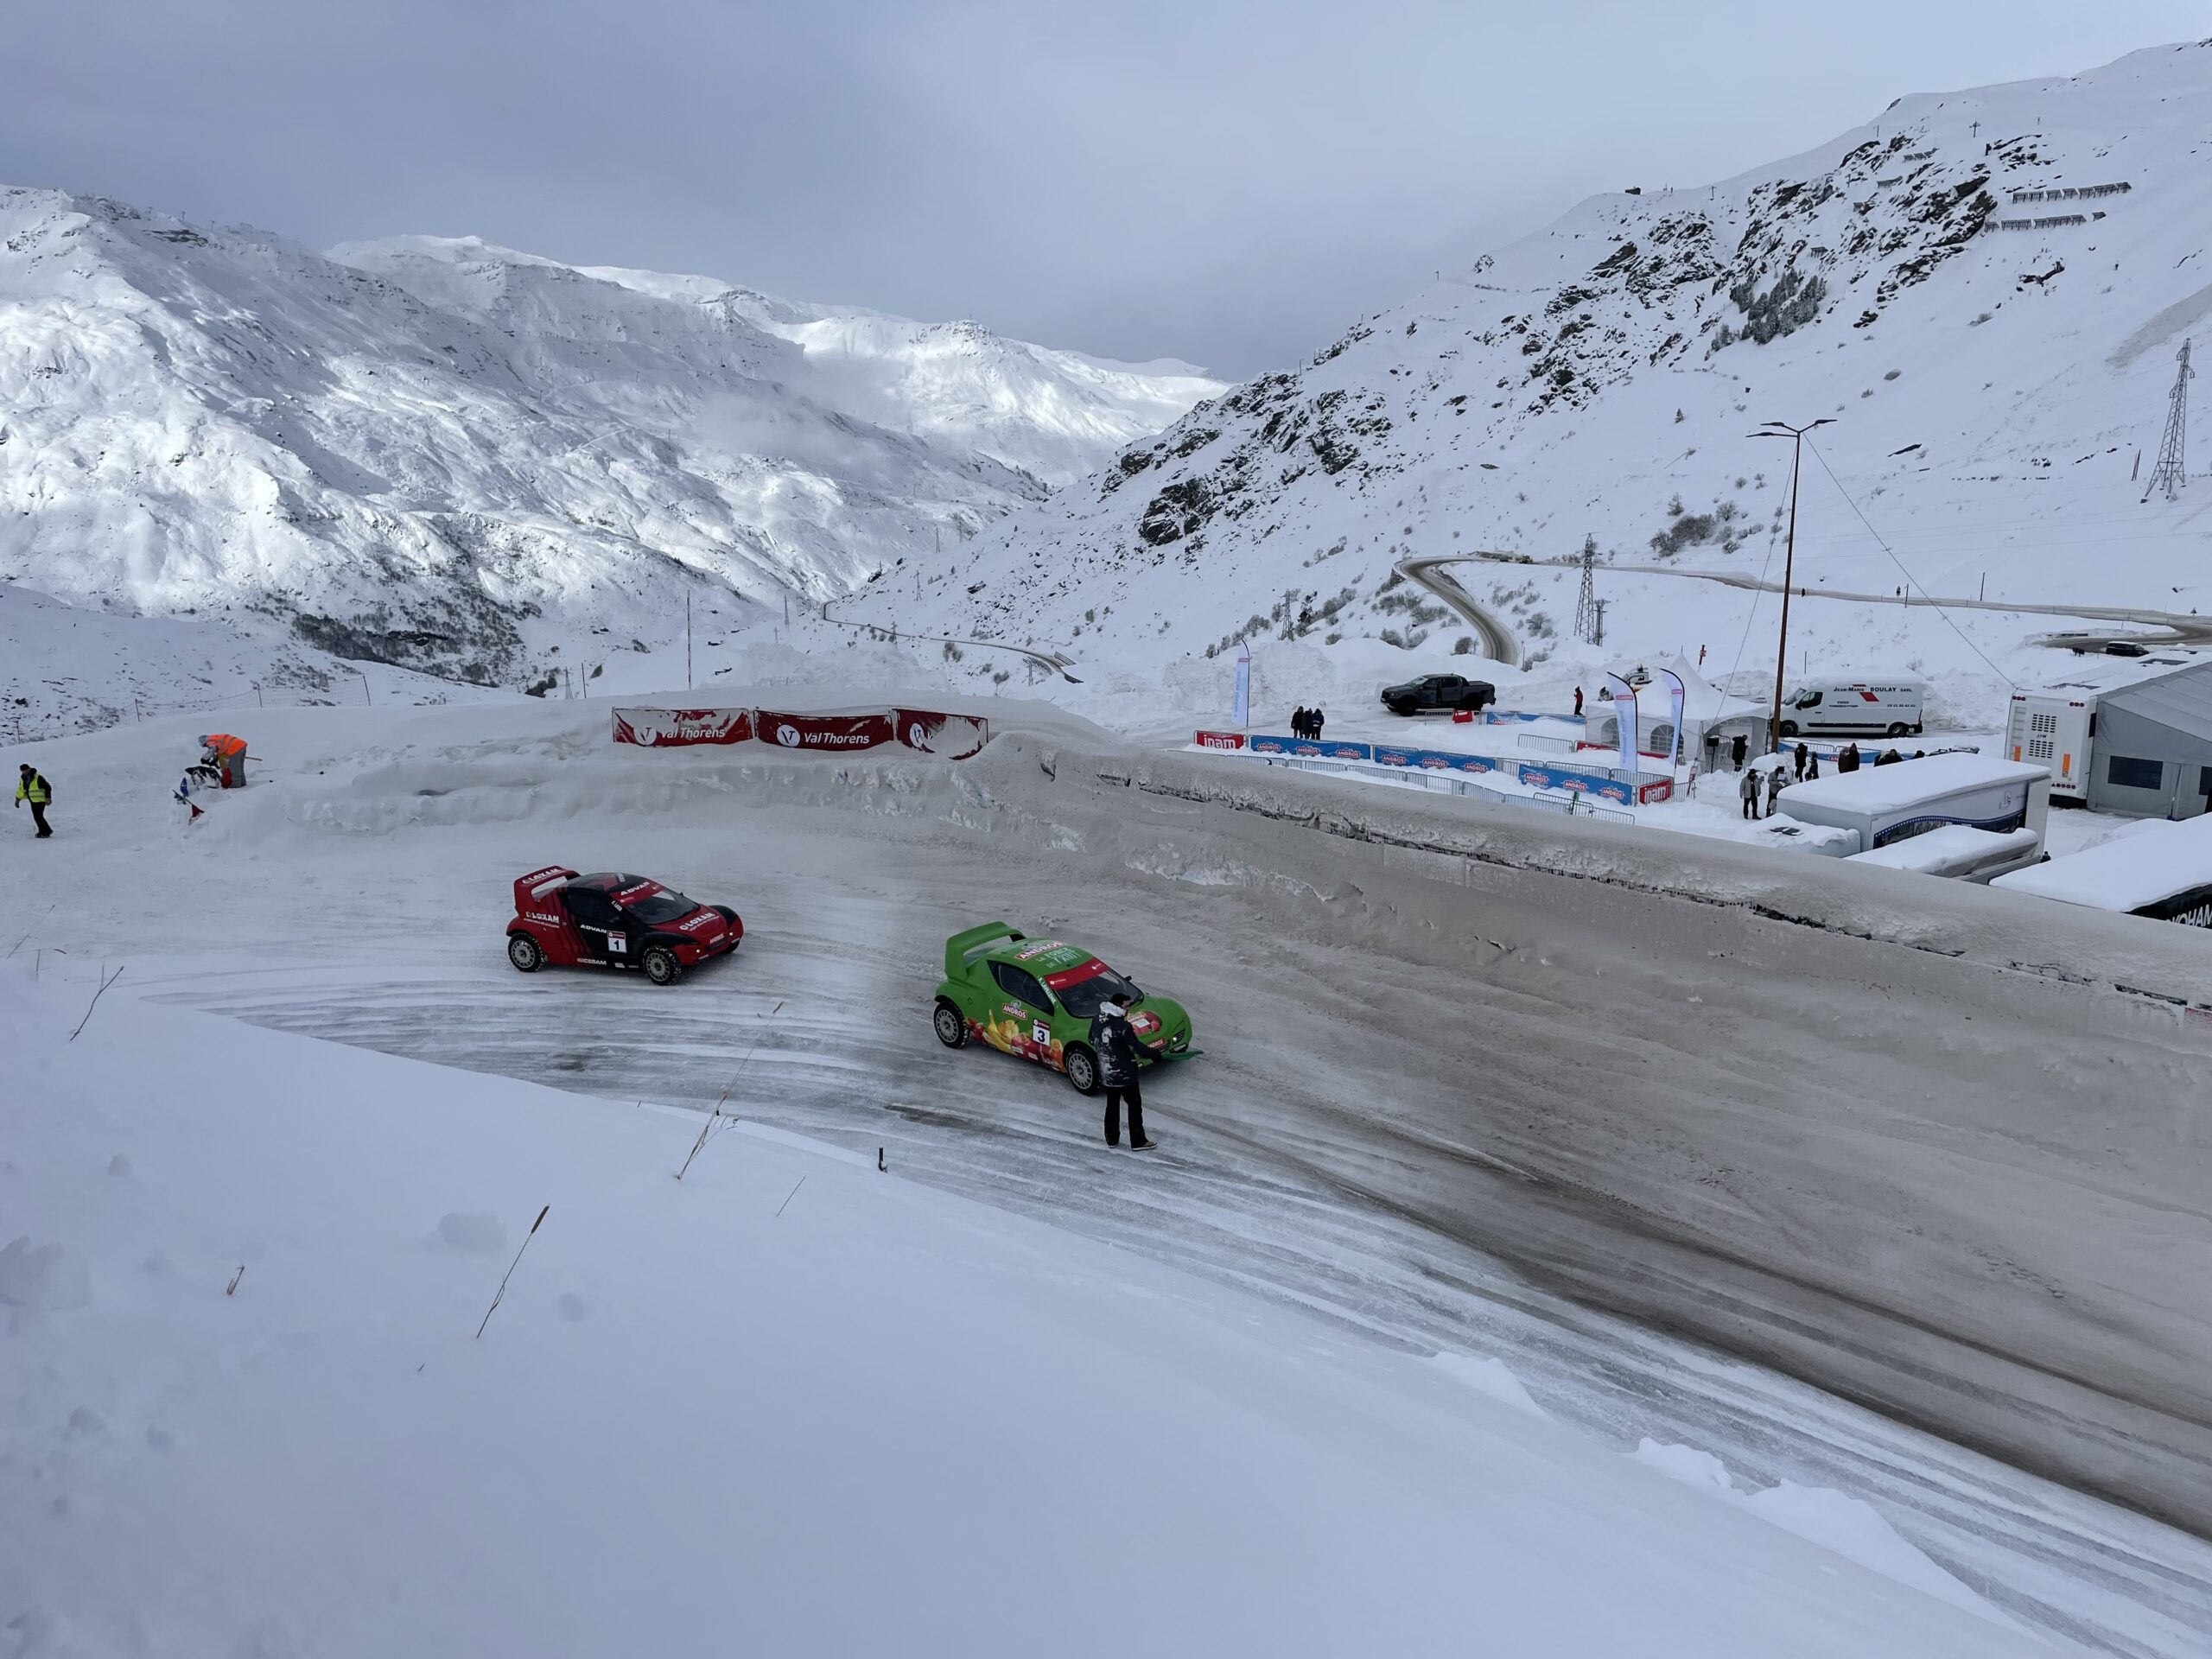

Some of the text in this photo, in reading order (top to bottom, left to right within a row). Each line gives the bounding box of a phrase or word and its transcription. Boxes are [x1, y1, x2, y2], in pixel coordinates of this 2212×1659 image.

[679, 728, 725, 739] Thorens
[804, 732, 870, 744] Val Thorens
[1382, 755, 1405, 764] ANDROS
[1424, 760, 1446, 768] ANDROS
[1465, 764, 1486, 772] ANDROS
[1525, 774, 1547, 783] ANDROS
[1564, 780, 1586, 790] ANDROS
[1602, 789, 1624, 798] ANDROS
[531, 912, 560, 924] LOXAM
[684, 912, 715, 926] LOXAM
[580, 924, 607, 933] ADVAN
[614, 940, 620, 950] 1
[1020, 940, 1064, 959] ANDROS
[1003, 1005, 1027, 1019] ANDROS
[1038, 1030, 1046, 1042] 3
